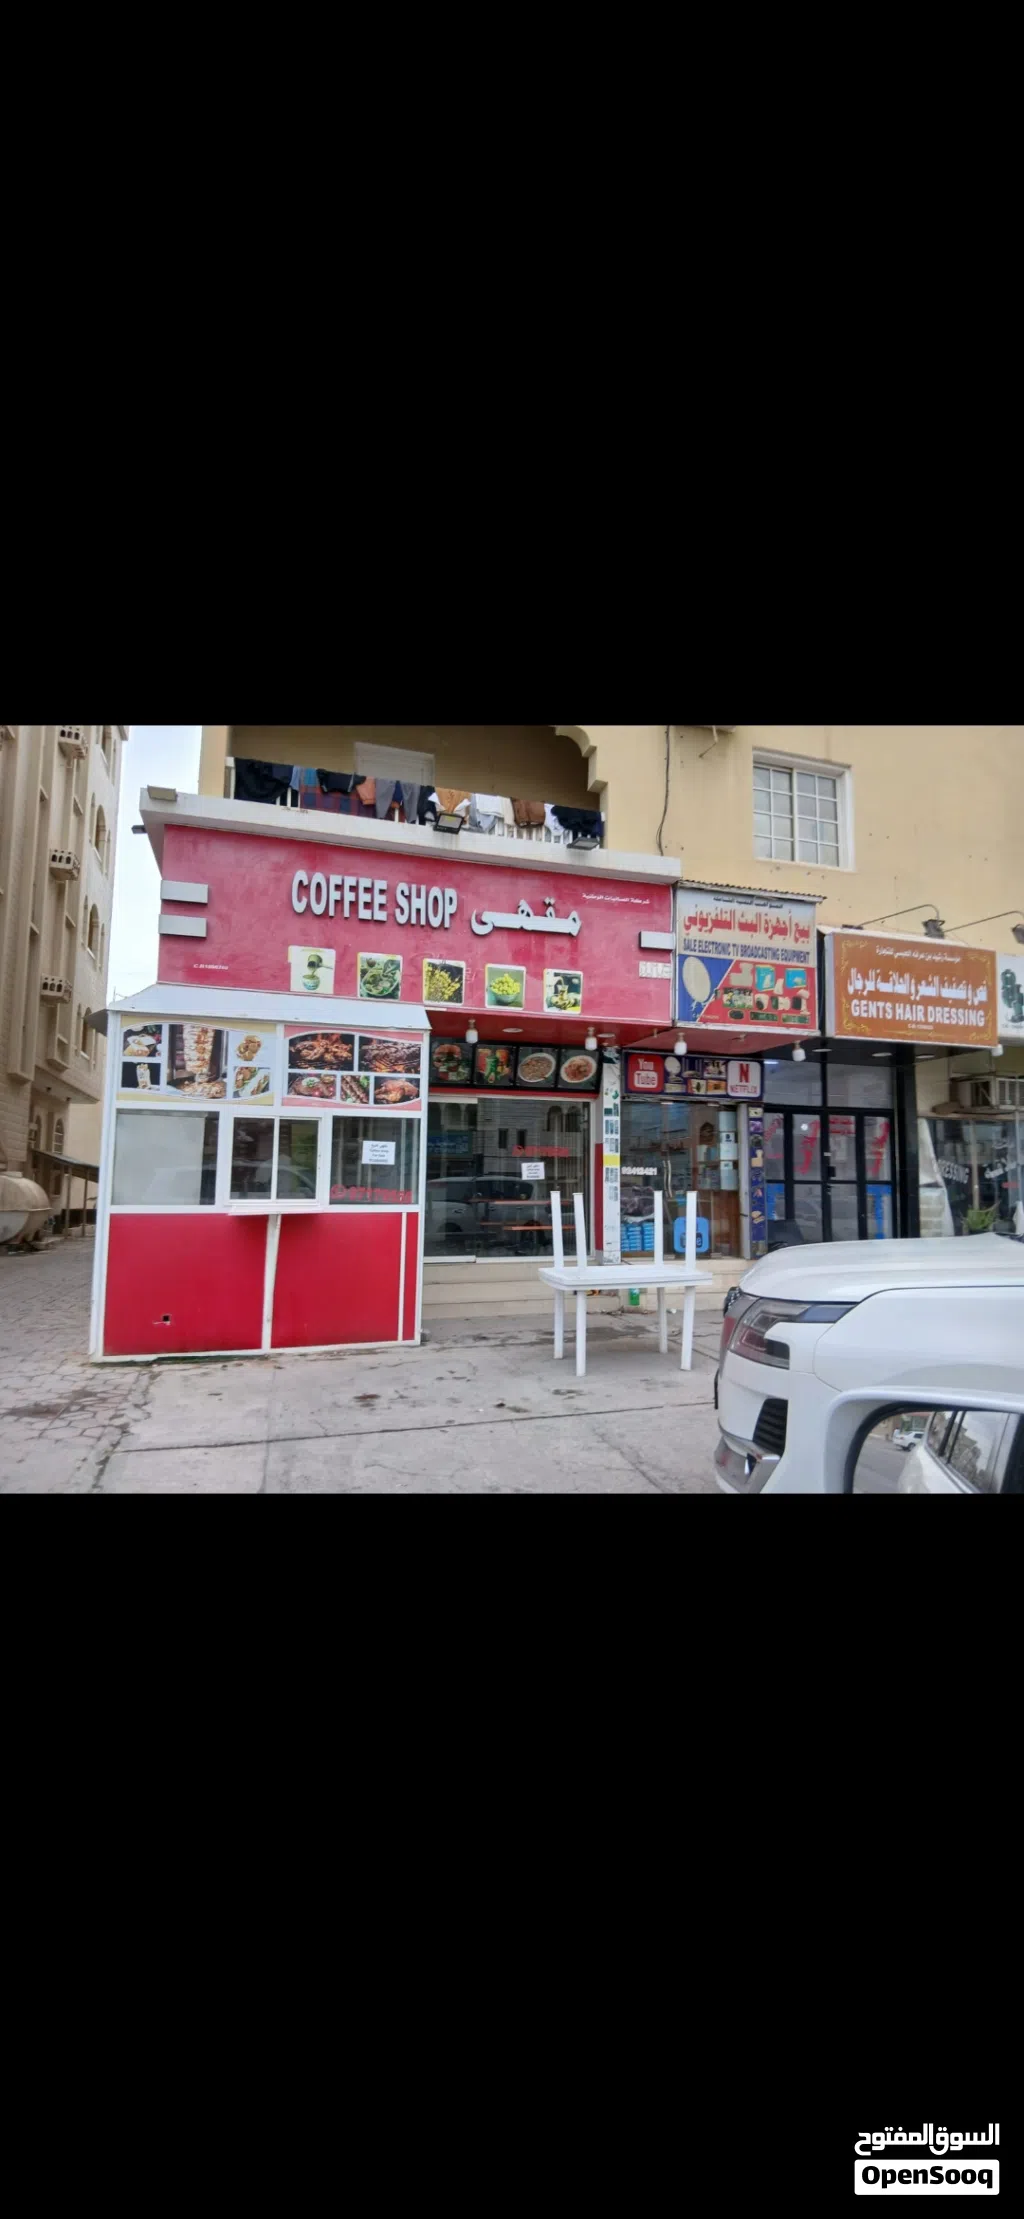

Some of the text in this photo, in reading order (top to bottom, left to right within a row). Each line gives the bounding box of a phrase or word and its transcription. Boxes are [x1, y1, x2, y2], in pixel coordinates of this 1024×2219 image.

[291, 869, 458, 929] COFFEE SHOP
[470, 896, 583, 937] مقهى
[683, 904, 810, 944] بيع أجهزة البث التلفزيوني
[683, 938, 810, 964] SALE ELECTRONIC TV BROADCASTING EQUIPMENT
[847, 967, 877, 996] للرجال
[916, 974, 940, 1000] الشعر
[851, 999, 985, 1027] GENTS HAIR DRESSING
[638, 1058, 654, 1071] You
[738, 1063, 750, 1083] N
[636, 1072, 657, 1086] Tube
[729, 1084, 758, 1094] NETFLIX
